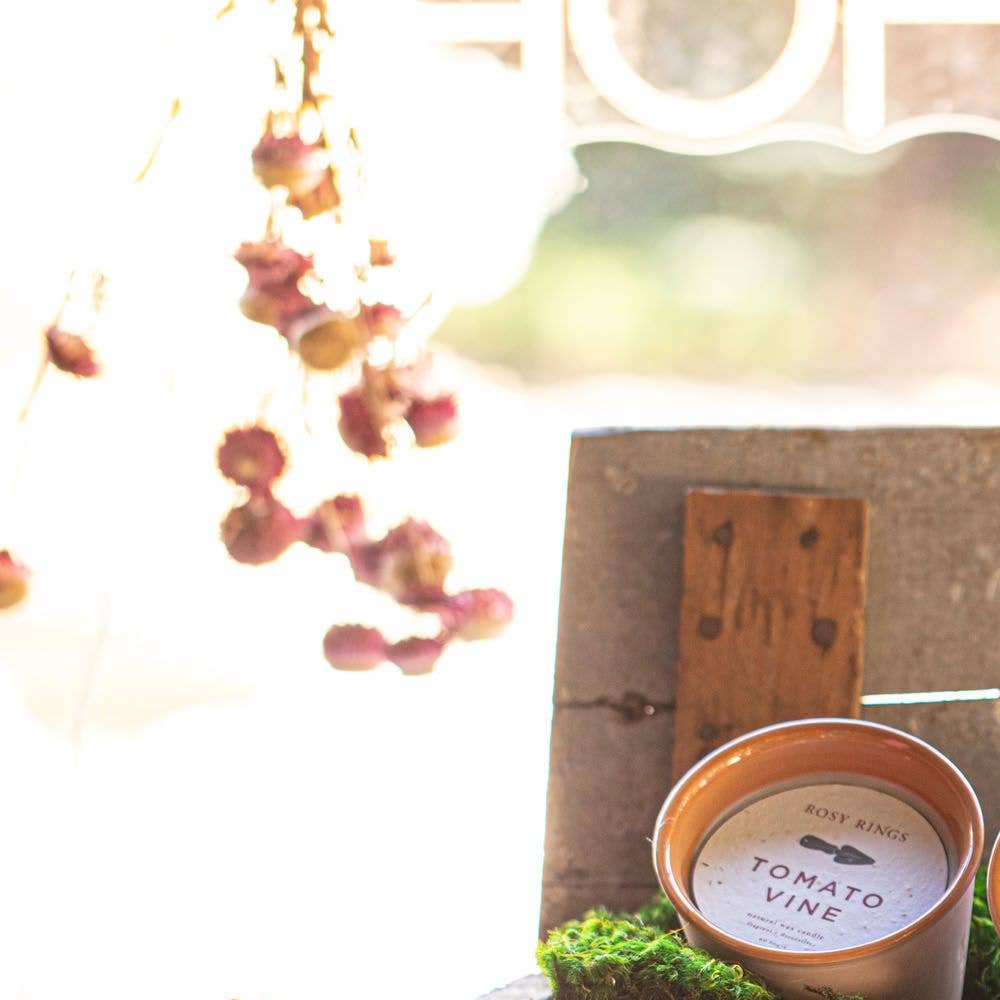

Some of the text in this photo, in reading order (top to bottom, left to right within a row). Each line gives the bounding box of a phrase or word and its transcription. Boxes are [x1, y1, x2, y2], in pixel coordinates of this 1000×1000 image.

[804, 803, 910, 843] ROSY RINGS
[751, 856, 884, 909] TOMATO
[765, 887, 842, 923] VINE
